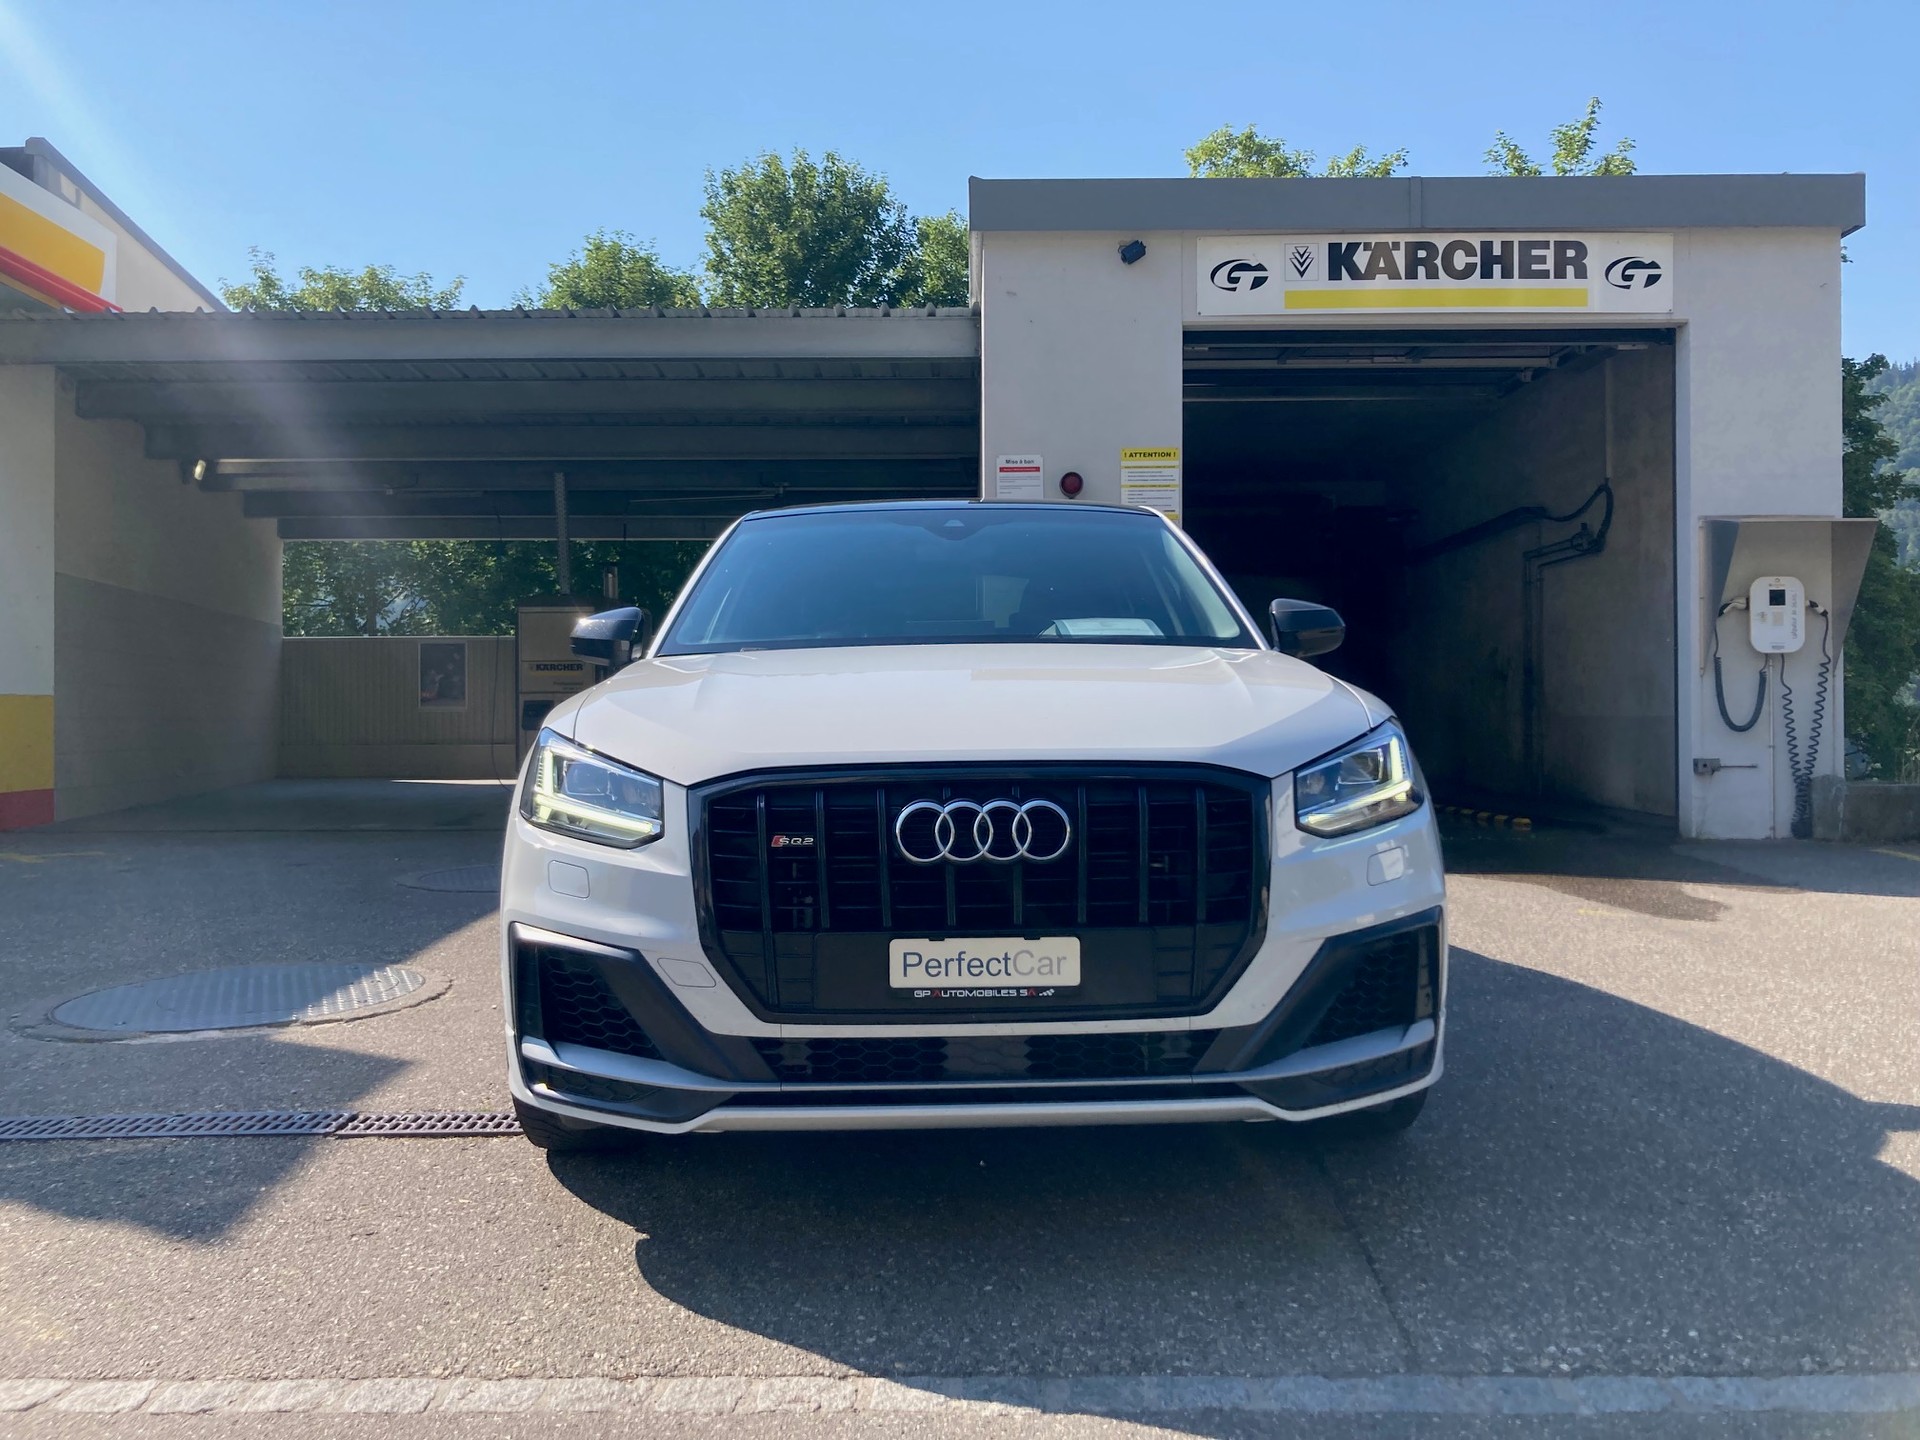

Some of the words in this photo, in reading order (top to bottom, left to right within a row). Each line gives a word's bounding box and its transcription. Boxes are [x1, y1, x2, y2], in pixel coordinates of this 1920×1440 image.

[1328, 239, 1588, 281] KÄRCHER
[779, 837, 814, 846] SQ2
[902, 950, 1067, 978] PerfectCar
[914, 990, 931, 998] GP
[932, 989, 1017, 998] AUTOMOBILES
